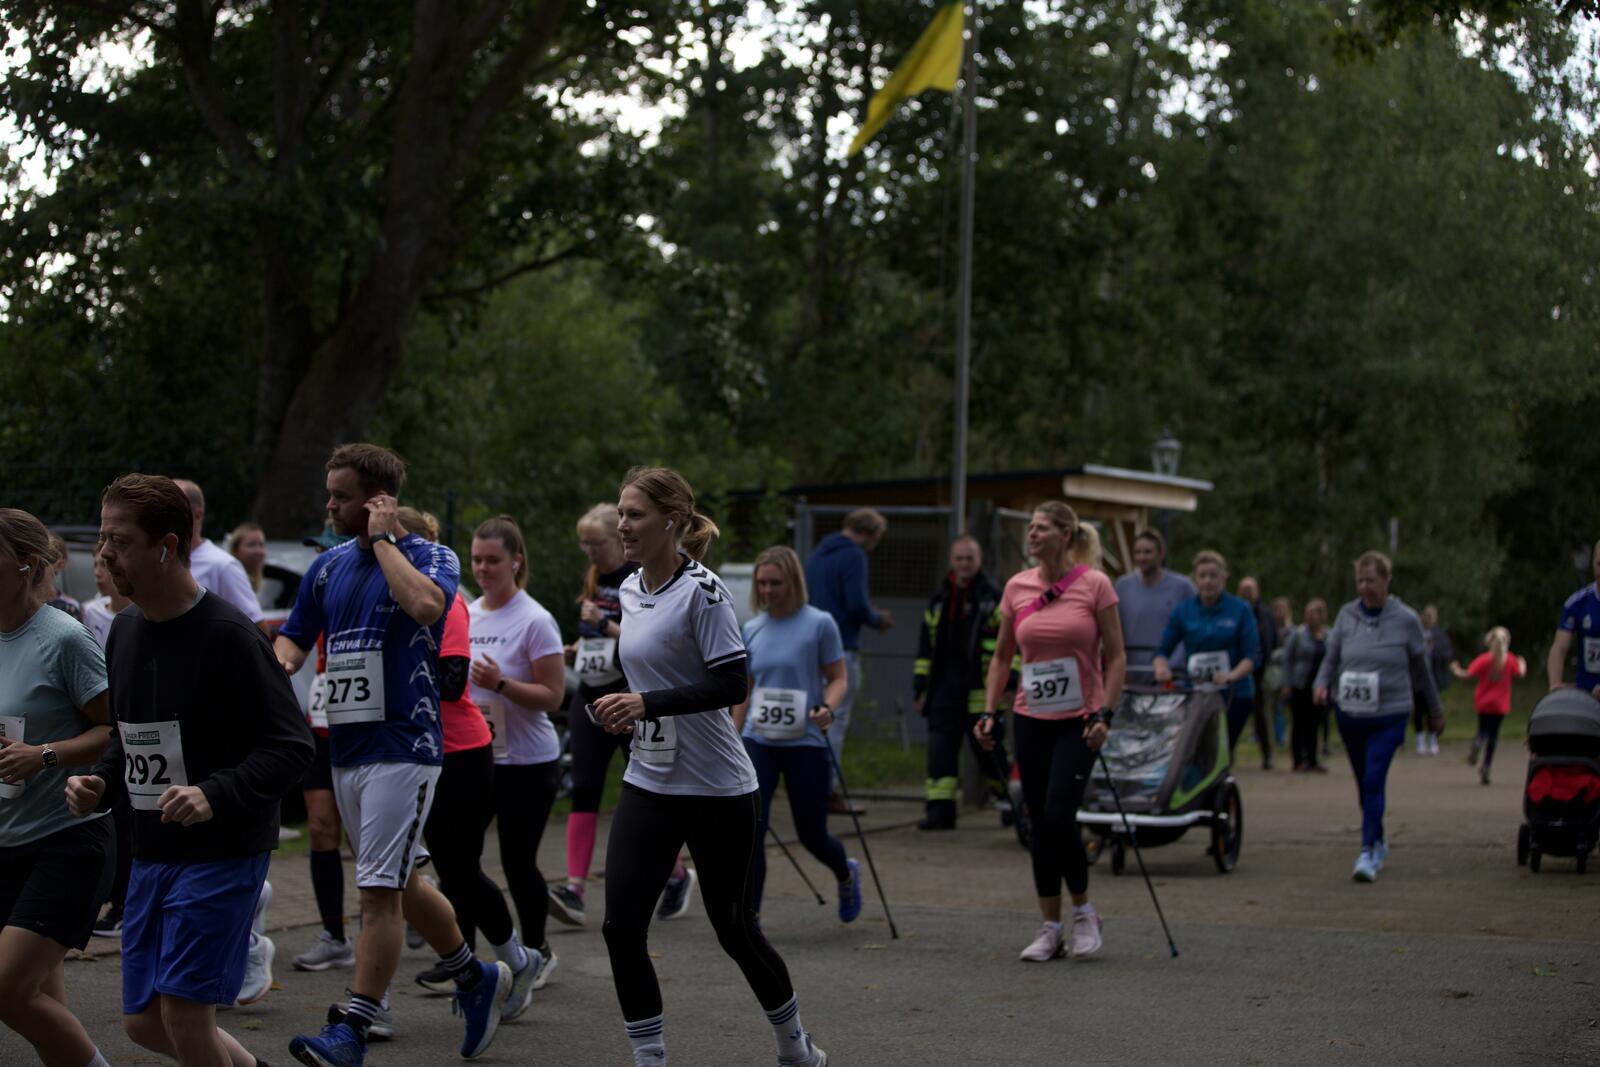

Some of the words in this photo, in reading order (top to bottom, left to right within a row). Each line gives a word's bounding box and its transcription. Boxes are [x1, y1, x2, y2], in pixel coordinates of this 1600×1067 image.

[581, 655, 607, 673] 242
[328, 677, 370, 704] 273
[1031, 676, 1069, 699] 397
[1344, 686, 1371, 702] 243
[758, 705, 795, 726] 395
[126, 753, 171, 785] 292
